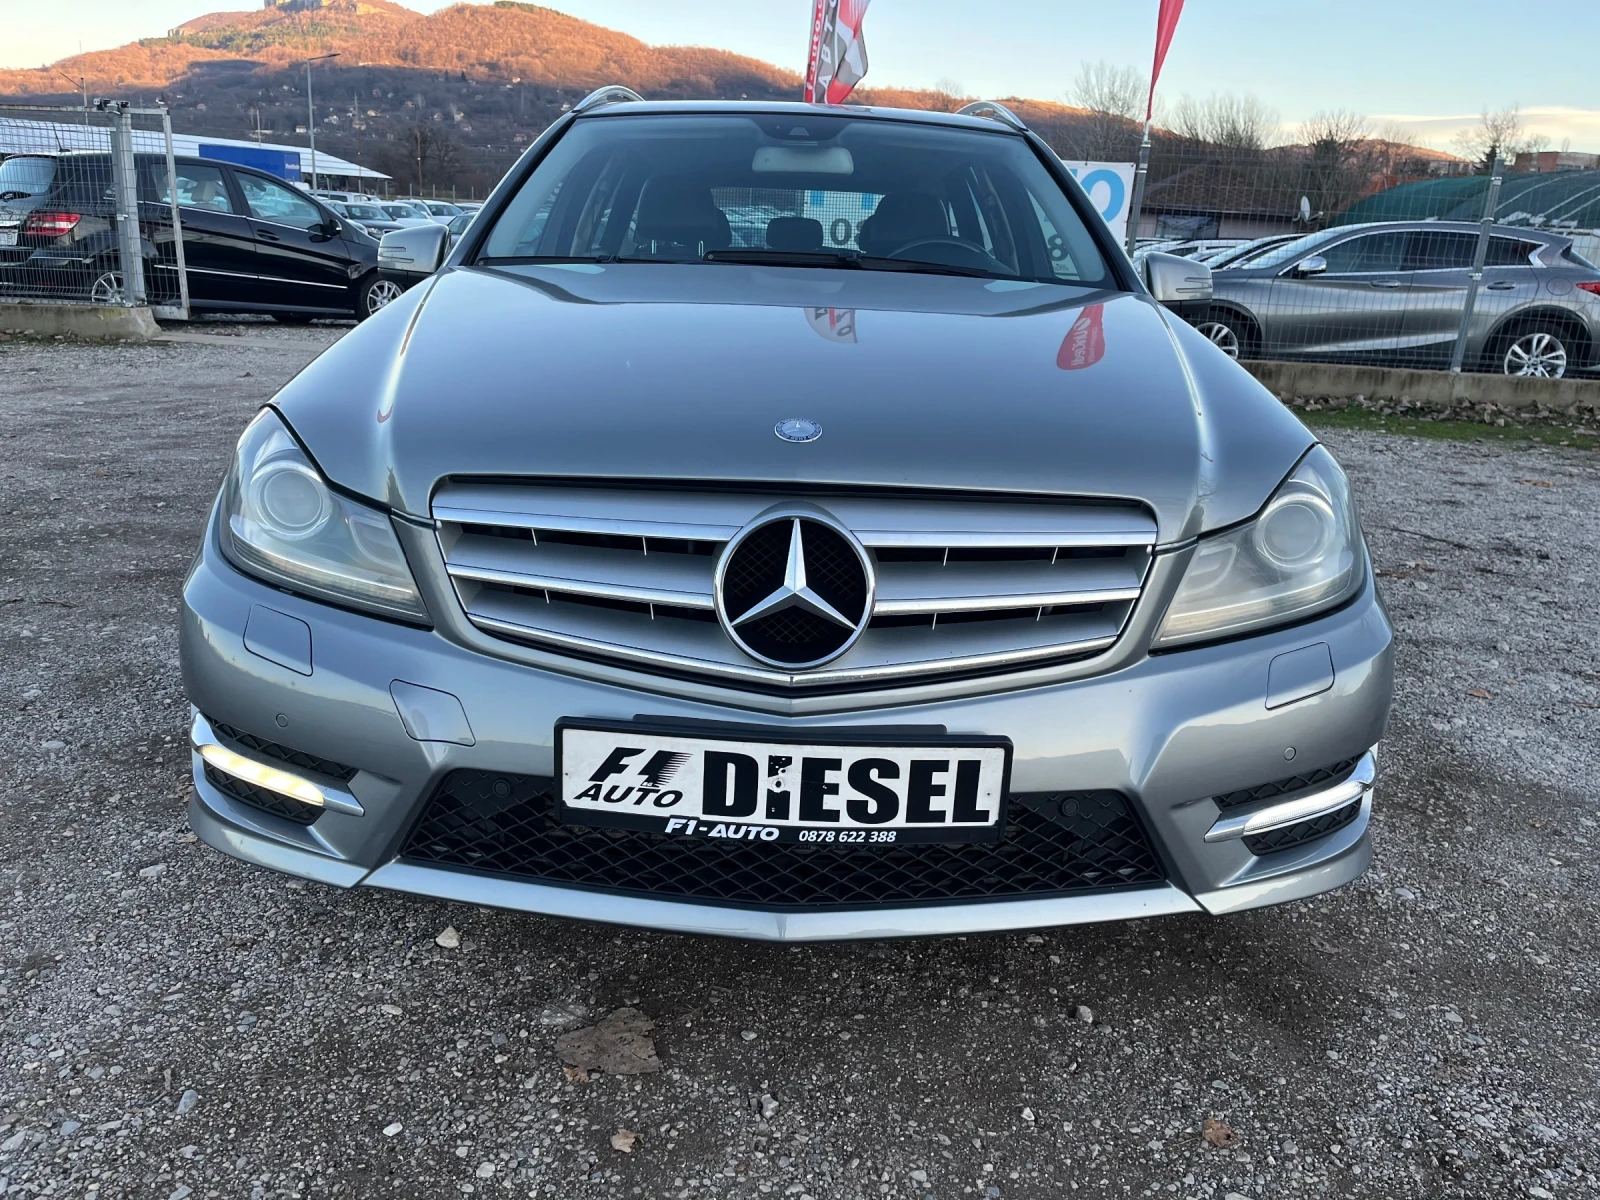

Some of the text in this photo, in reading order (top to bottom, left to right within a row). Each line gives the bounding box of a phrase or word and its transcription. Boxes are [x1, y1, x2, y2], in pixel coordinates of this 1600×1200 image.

[573, 783, 683, 808] AUTO
[702, 750, 990, 824] DIESEL
[665, 817, 780, 841] F1-AUTO
[799, 830, 897, 843] 0878 622 388
